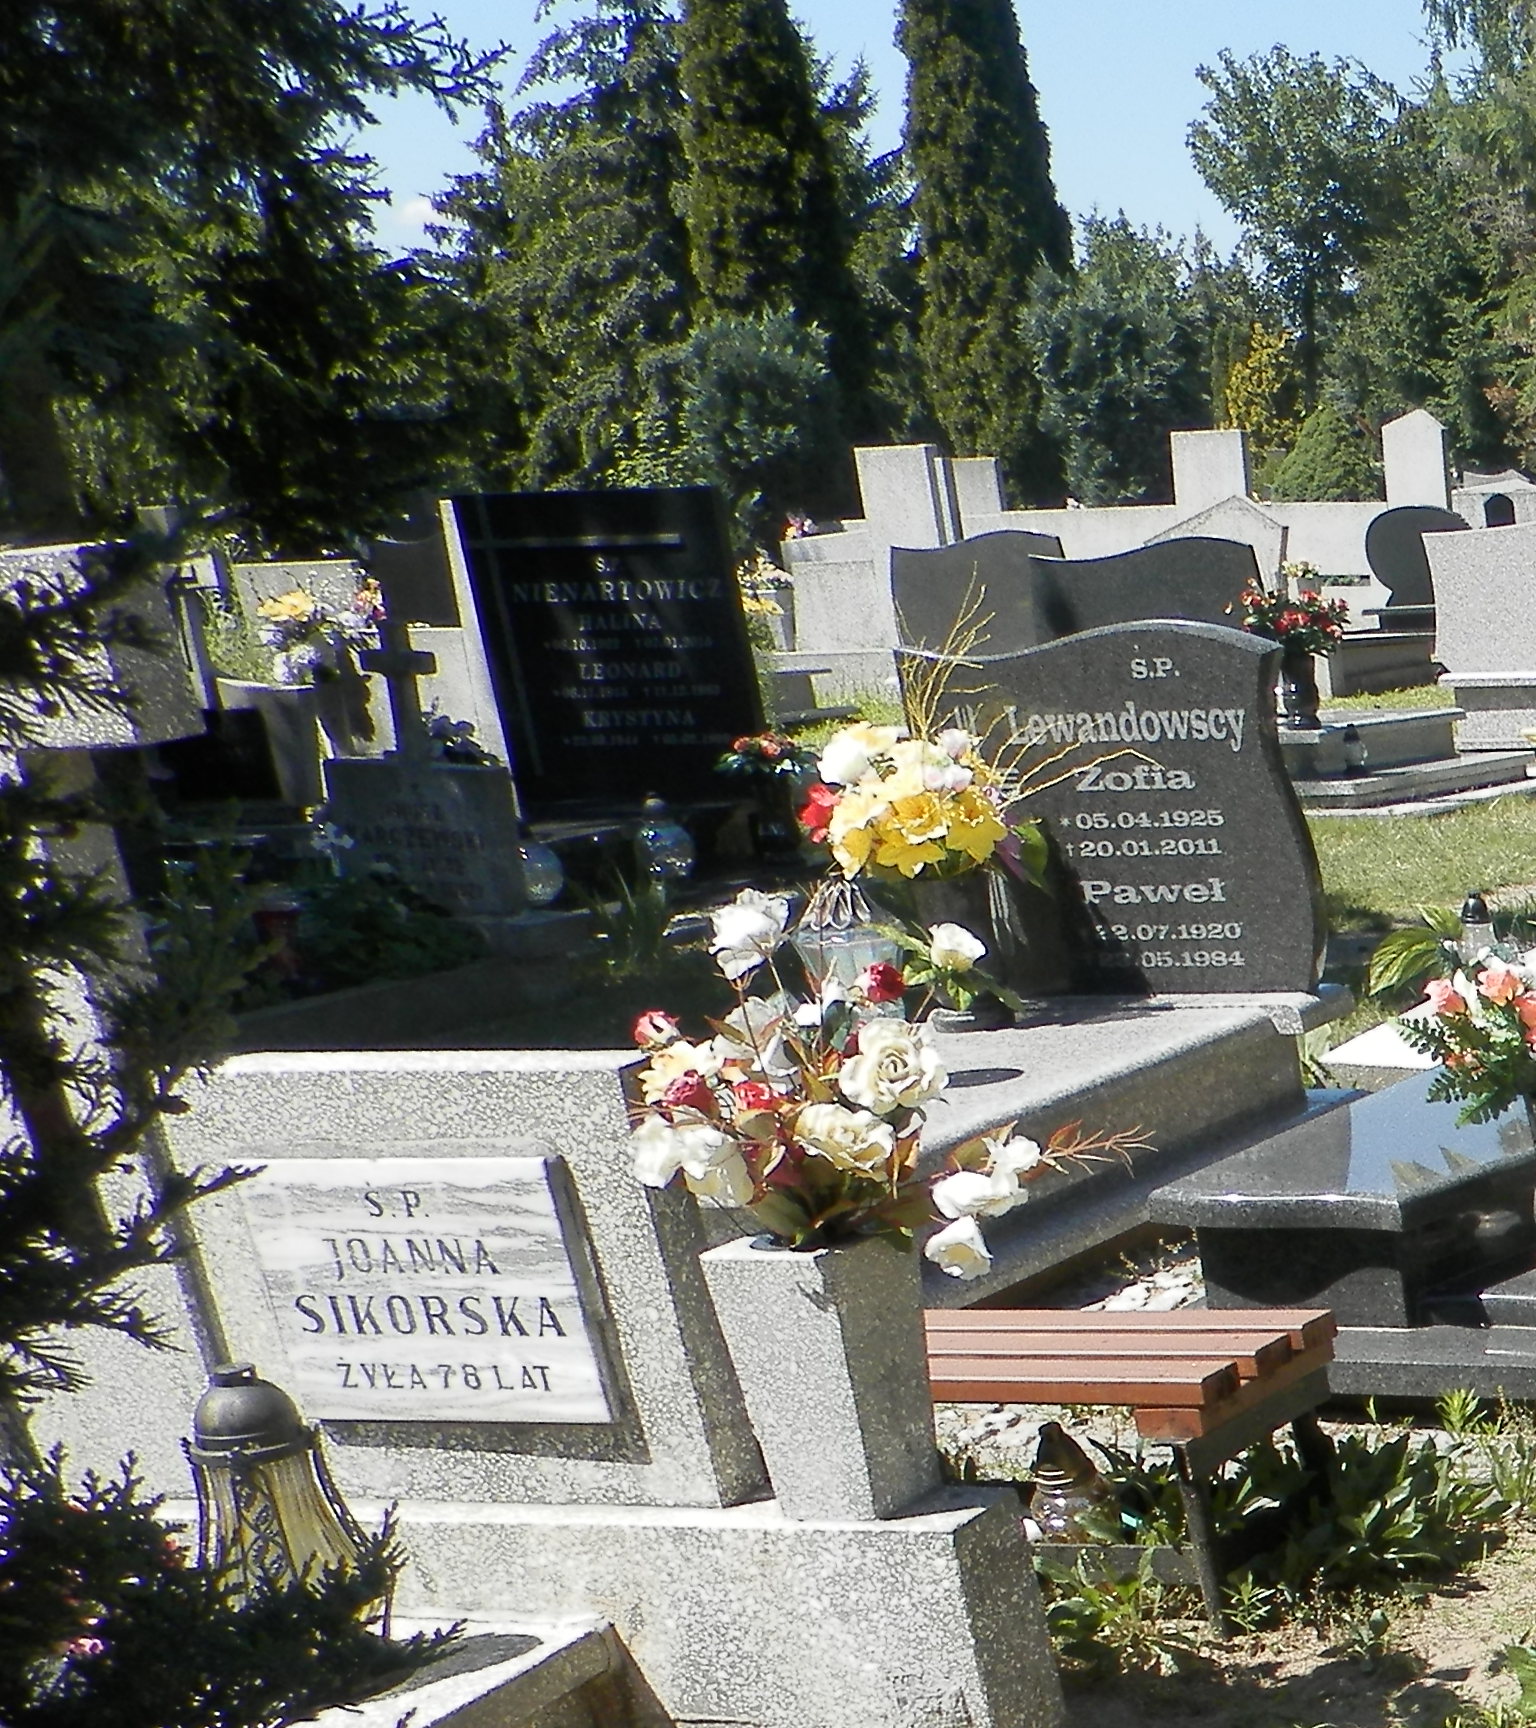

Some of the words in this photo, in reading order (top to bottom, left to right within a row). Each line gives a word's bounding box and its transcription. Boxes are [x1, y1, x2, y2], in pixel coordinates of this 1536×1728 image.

[1007, 702, 1246, 752] Lewandowscy
[1075, 767, 1198, 793] Zofia
[1081, 877, 1227, 904] Paweł
[322, 1238, 501, 1281] JOANNA
[295, 1294, 568, 1338] SIKORSKA
[437, 1363, 482, 1390] 78
[493, 1364, 554, 1392] LAT
